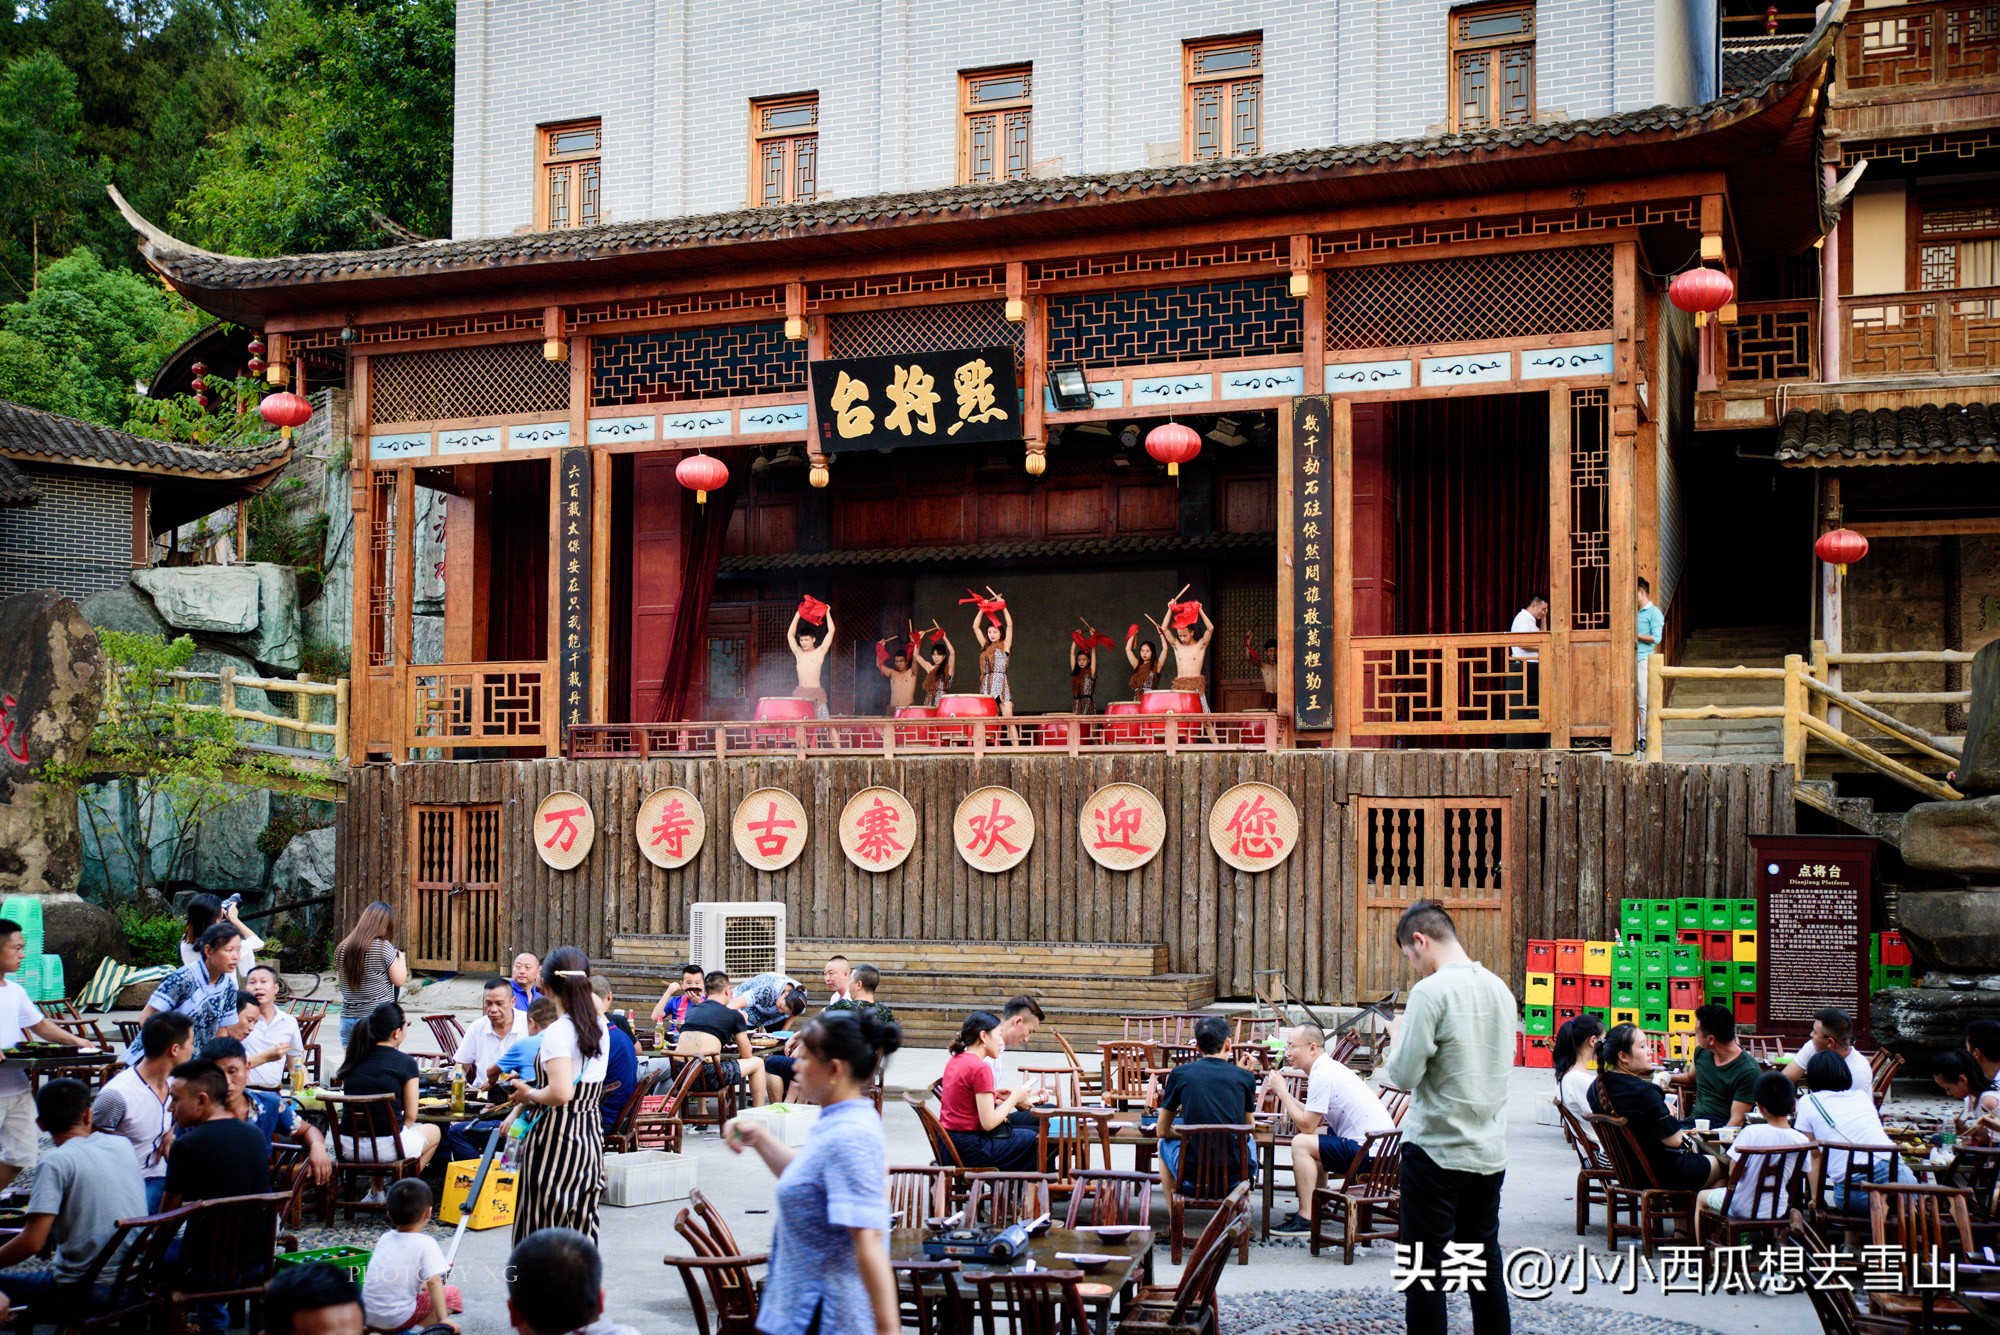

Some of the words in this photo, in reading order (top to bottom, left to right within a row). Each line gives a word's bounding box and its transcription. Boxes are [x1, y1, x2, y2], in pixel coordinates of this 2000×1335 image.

[543, 796, 1284, 864] 万寿古寨欢迎您
[1797, 863, 1842, 879] 点将台
